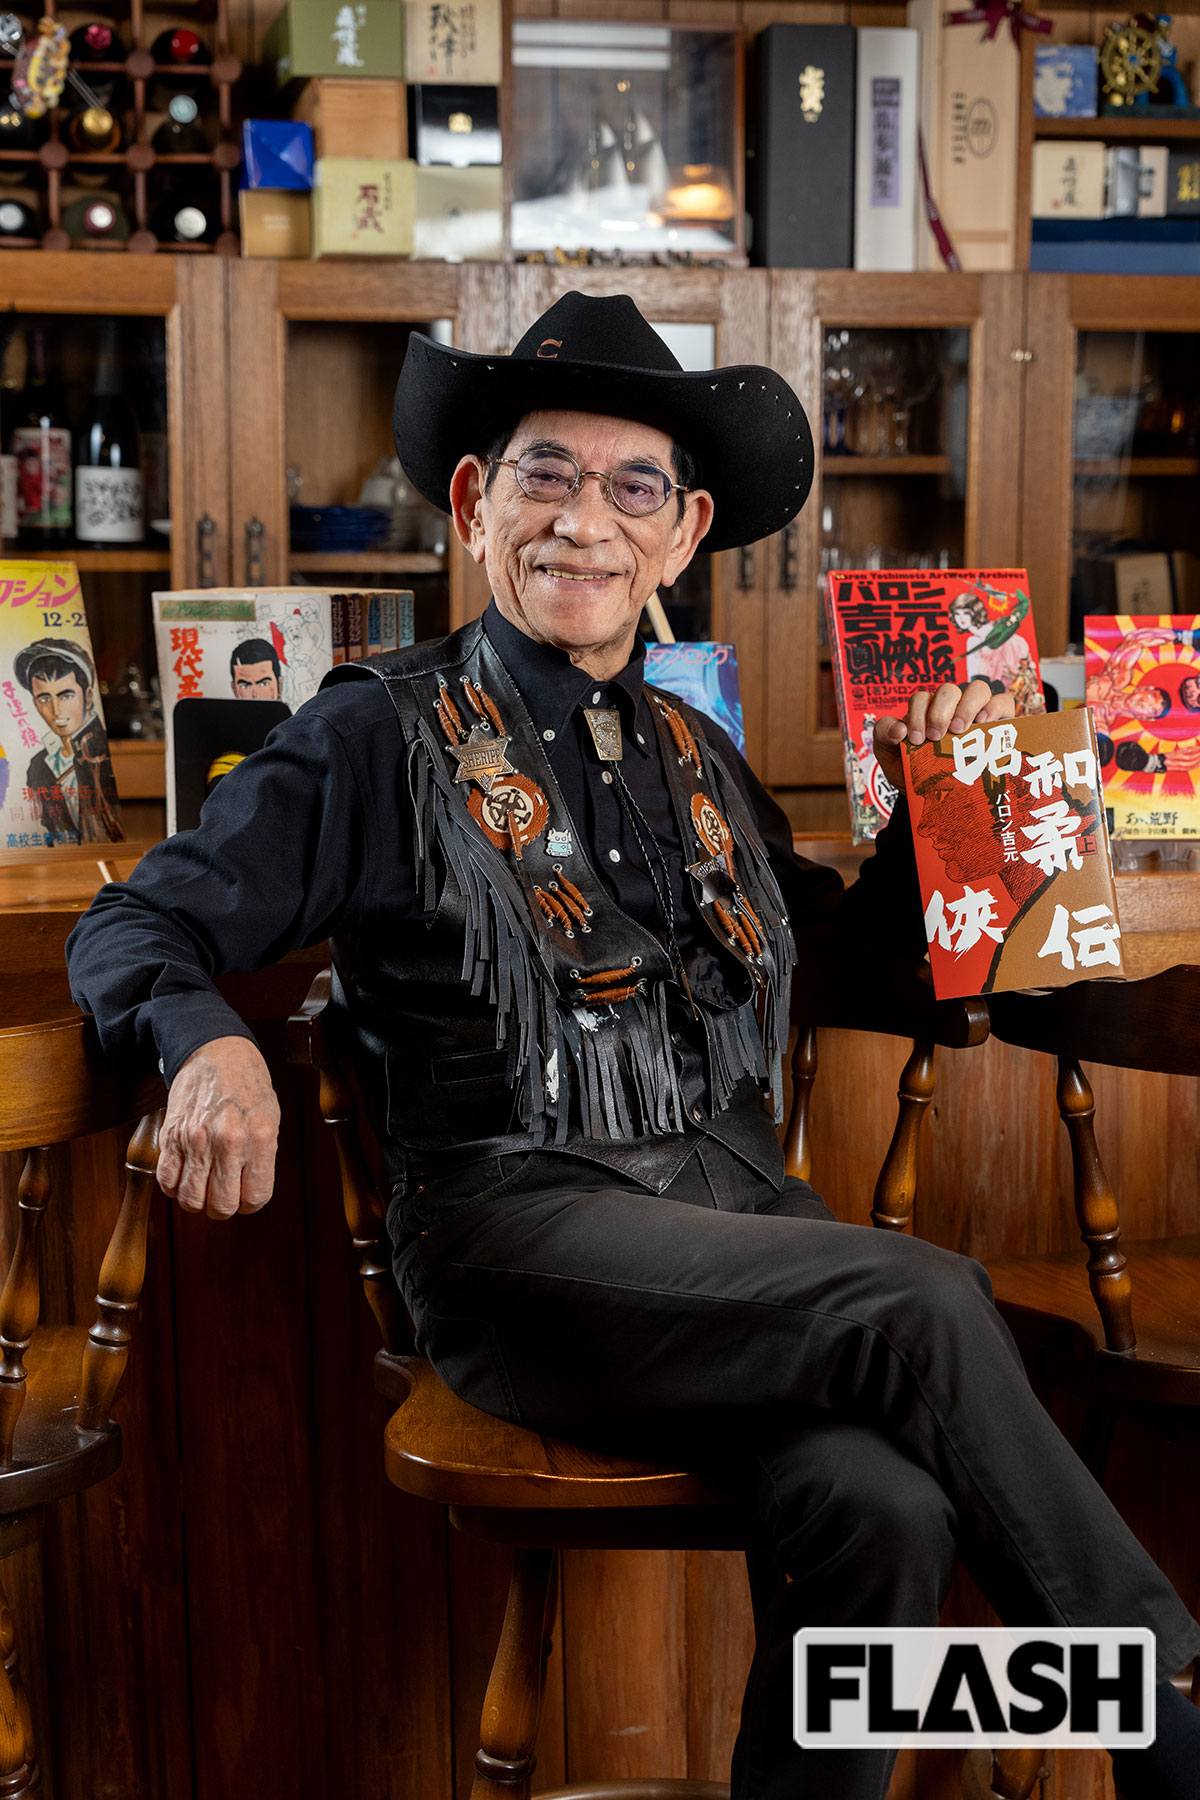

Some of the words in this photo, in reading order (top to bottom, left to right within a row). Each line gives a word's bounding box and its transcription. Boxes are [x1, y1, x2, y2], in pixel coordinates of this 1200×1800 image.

[870, 572, 926, 580] Yoshimoto
[979, 571, 1024, 579] Archives
[837, 581, 946, 601] バロン
[837, 603, 948, 632] 吉元
[169, 627, 204, 699] 現代柔
[461, 749, 500, 769] SHERIFF
[996, 790, 1019, 863] バロン吉元
[1079, 837, 1097, 854] 上
